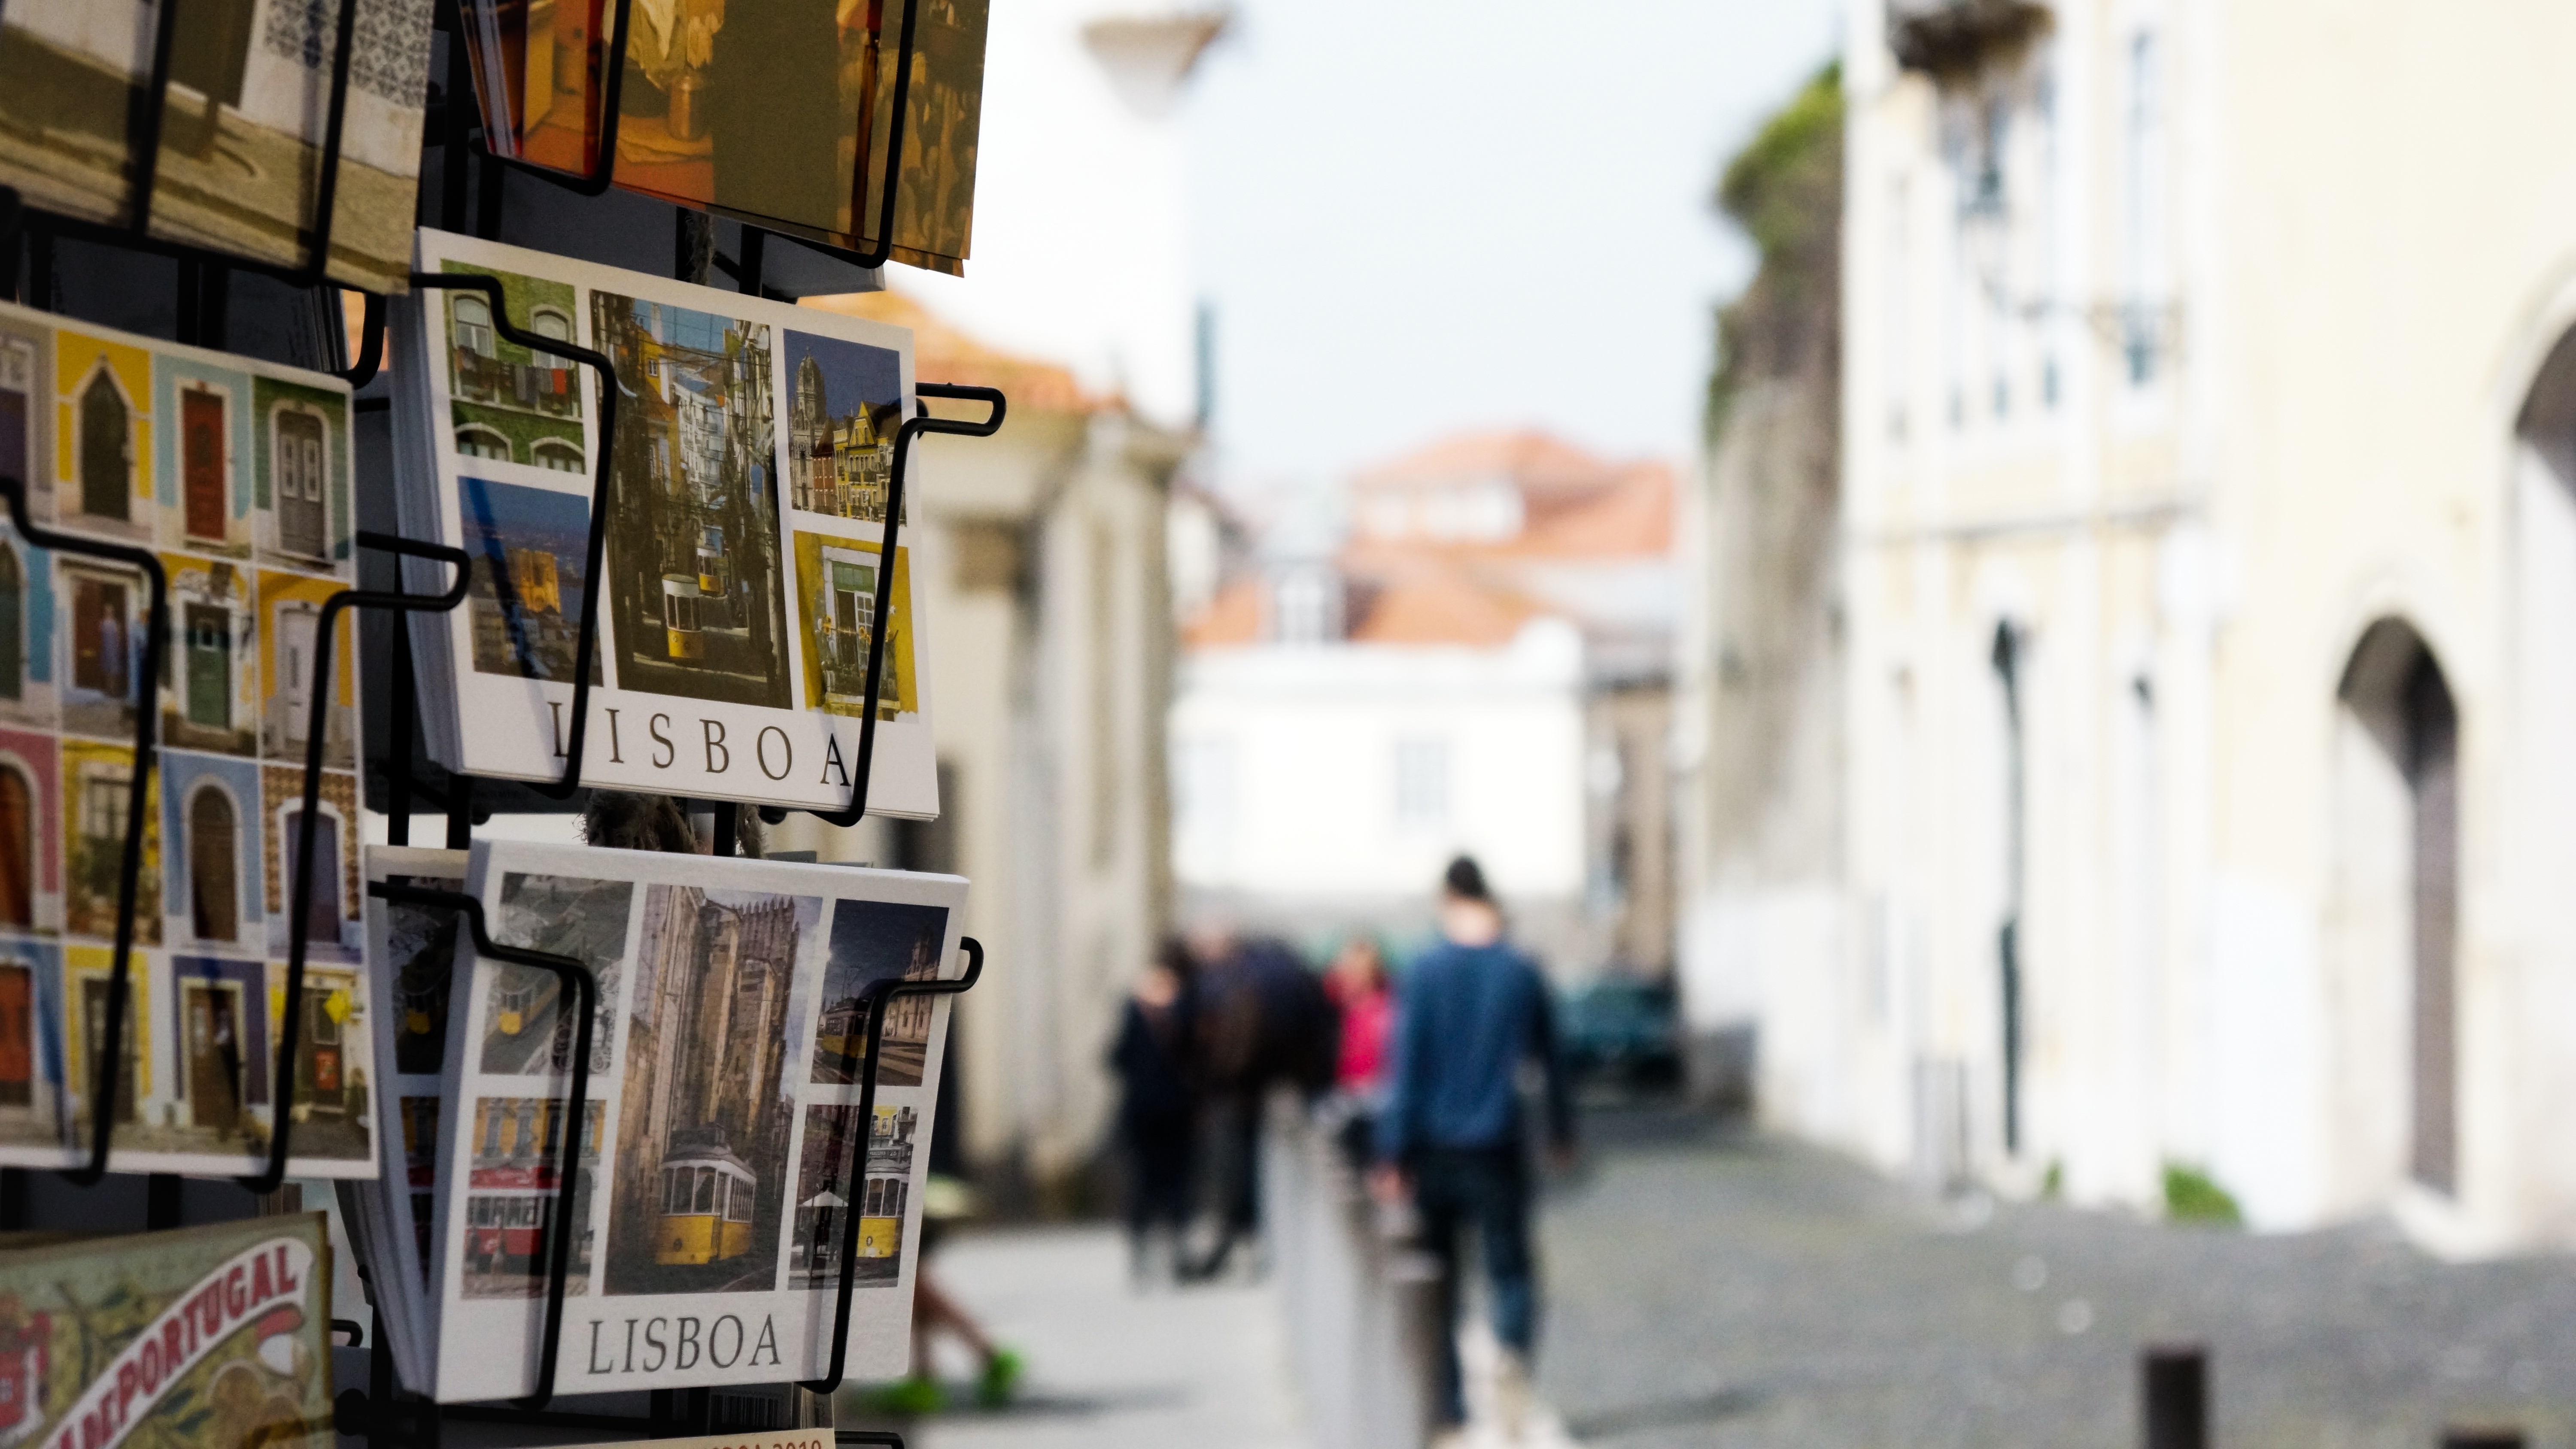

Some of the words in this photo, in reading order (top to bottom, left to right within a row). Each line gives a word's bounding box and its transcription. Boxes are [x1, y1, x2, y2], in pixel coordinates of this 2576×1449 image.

[547, 702, 852, 787] LISBOA
[117, 1246, 297, 1424] PORTUGAL
[588, 1313, 781, 1374] LISBOA
